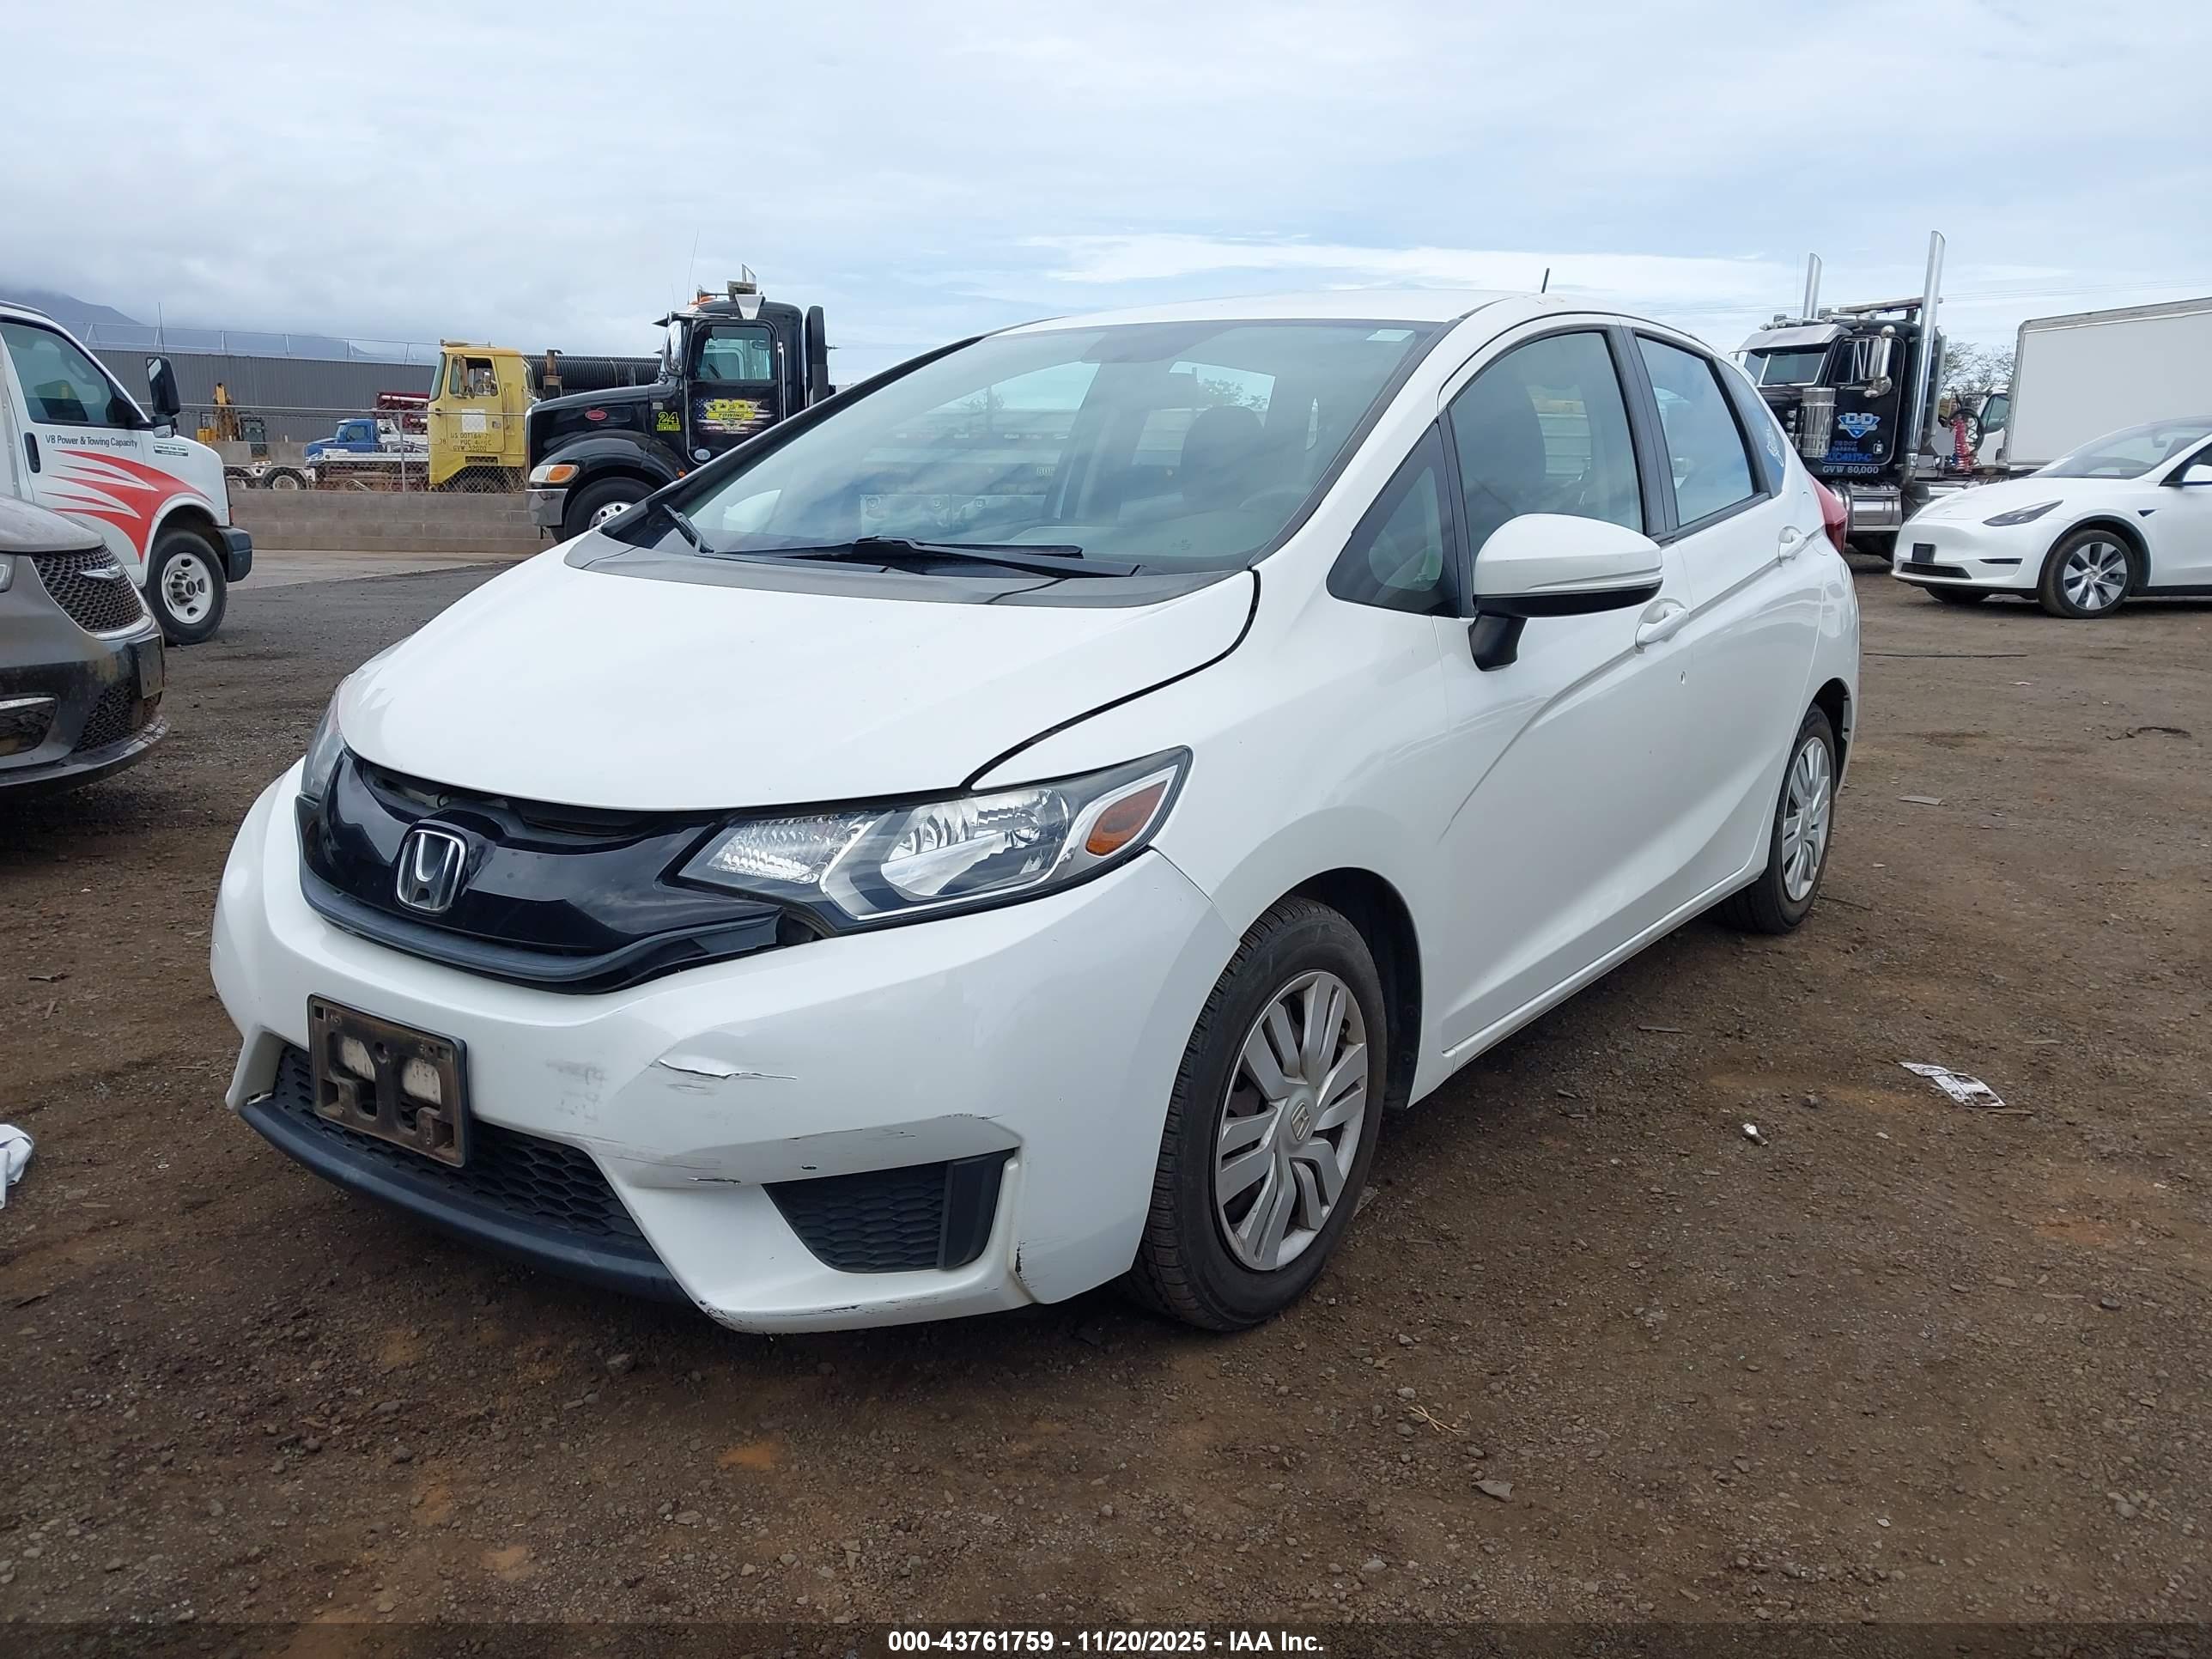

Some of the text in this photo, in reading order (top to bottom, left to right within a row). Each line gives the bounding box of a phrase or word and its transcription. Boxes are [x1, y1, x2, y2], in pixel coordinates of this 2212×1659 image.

[658, 411, 679, 424] 24
[45, 434, 138, 449] V8 Power & Towing Capacity
[1847, 465, 1879, 475] 80,000
